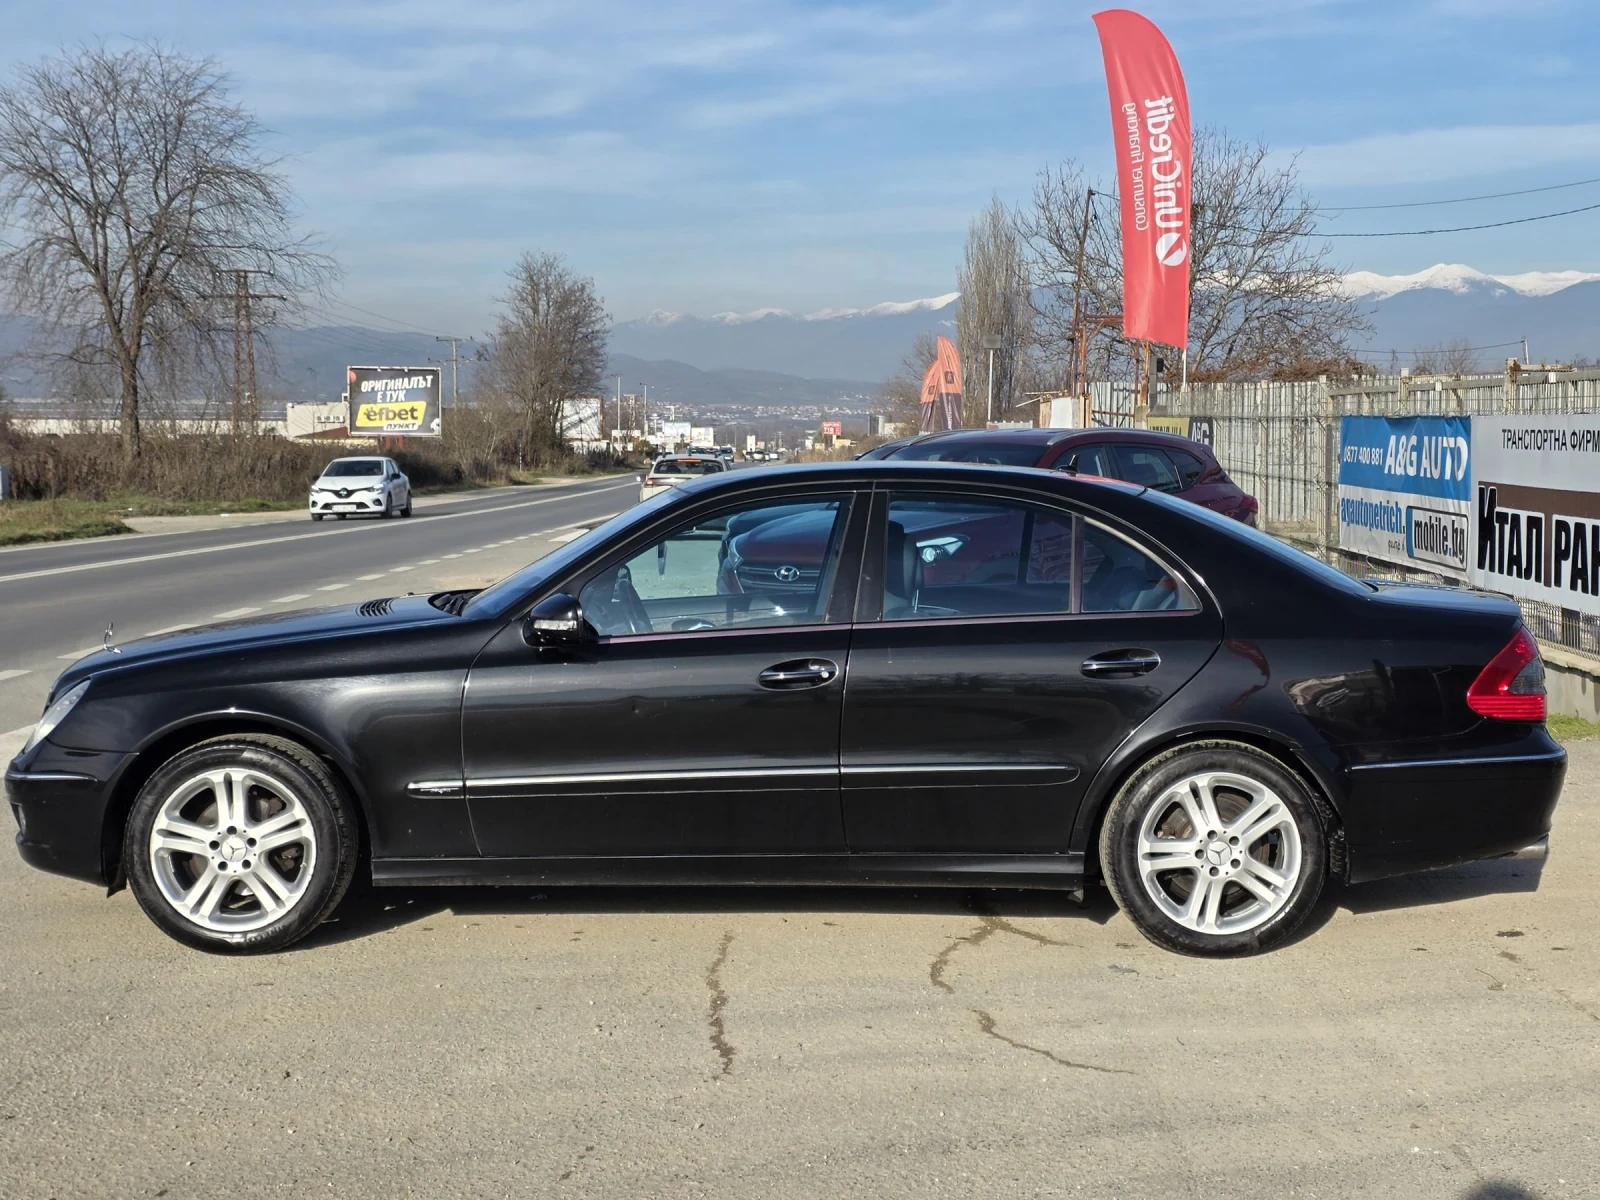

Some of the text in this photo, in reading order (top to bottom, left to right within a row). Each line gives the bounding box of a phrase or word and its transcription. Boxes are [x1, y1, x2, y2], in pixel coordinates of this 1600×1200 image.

[361, 375, 433, 392] ОРИГИНАЛЪТ
[386, 390, 406, 402] ТУК
[364, 406, 418, 421] efbet
[386, 422, 416, 430] ПУНКТ
[1502, 429, 1568, 451] ТРАНСПОРТНА
[1344, 446, 1384, 466] 0877 400 881
[1384, 434, 1468, 481] A&G AUTO
[1414, 515, 1465, 565] mobile.bg
[1478, 486, 1543, 583] ИТАЛ
